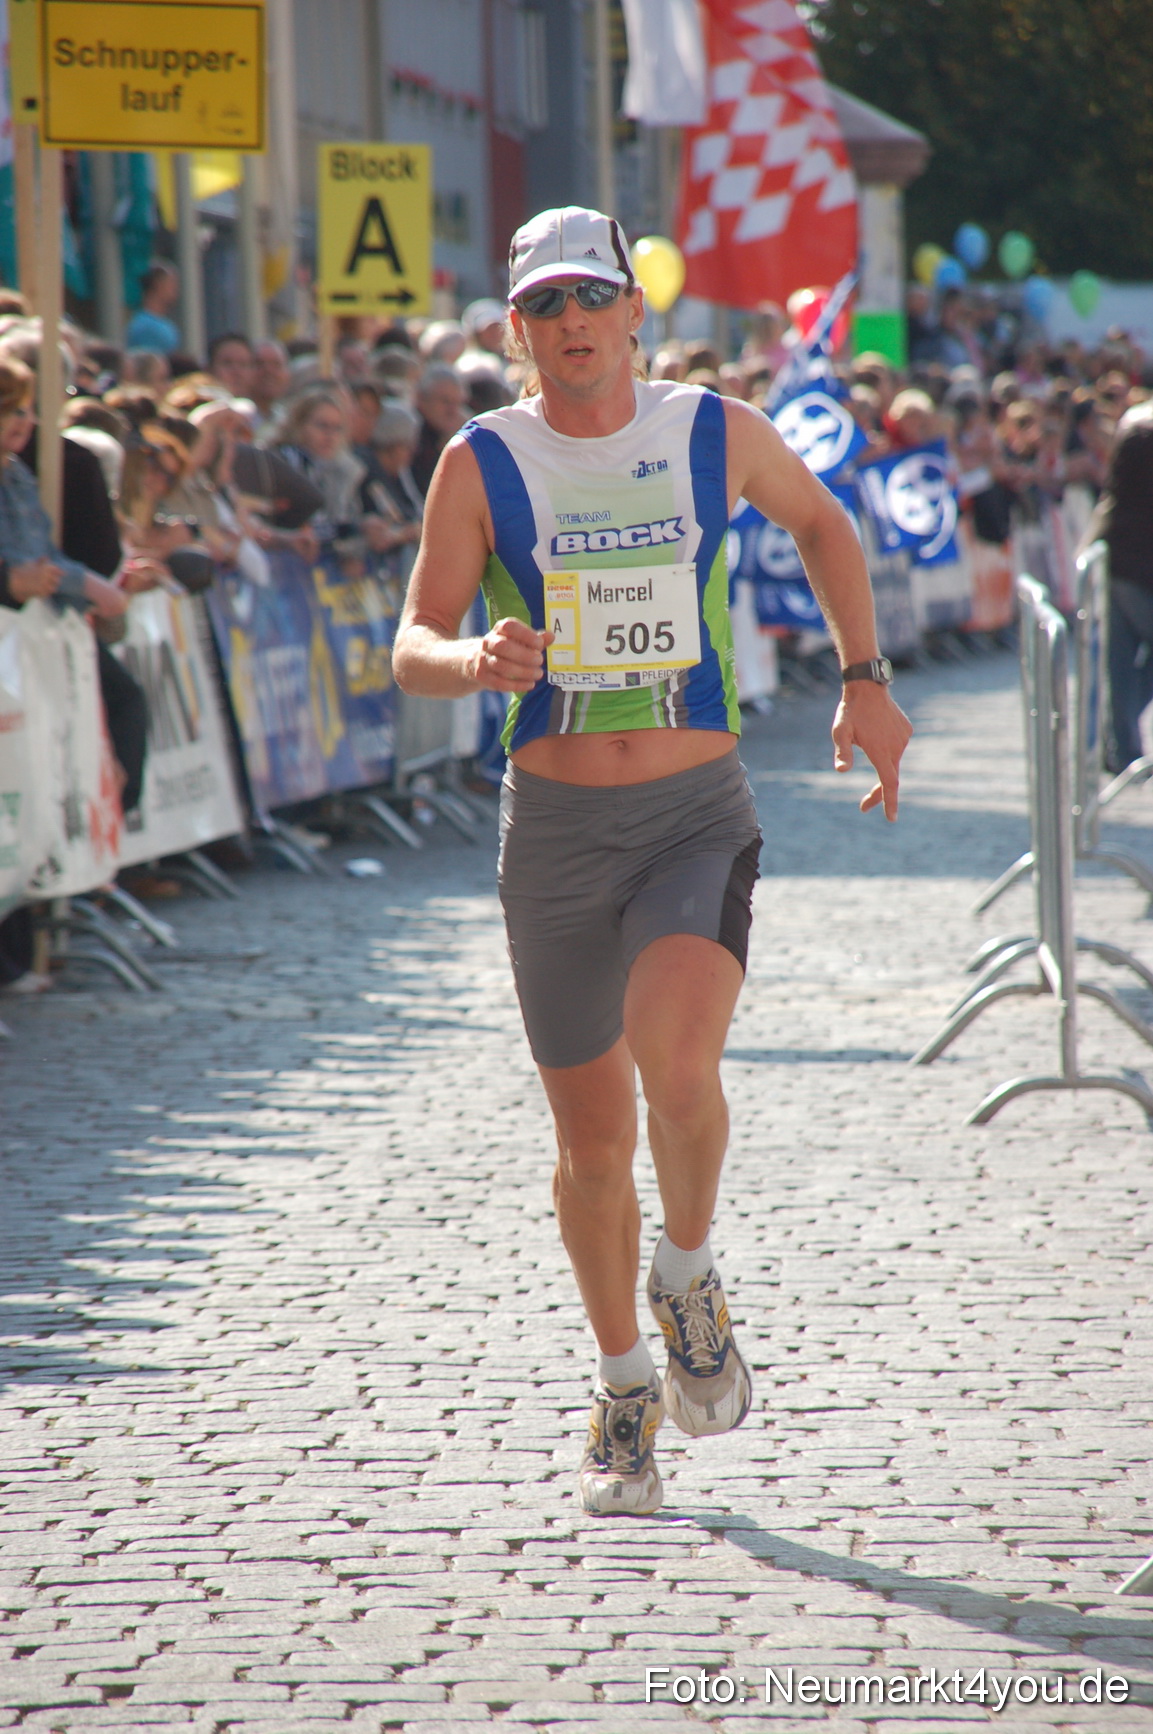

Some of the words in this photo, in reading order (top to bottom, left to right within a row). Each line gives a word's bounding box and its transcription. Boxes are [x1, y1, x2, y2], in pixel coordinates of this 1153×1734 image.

[54, 38, 248, 77] Schnupper-
[121, 83, 183, 112] lauf
[331, 150, 417, 182] Block
[346, 197, 404, 276] A
[556, 511, 610, 524] TEAM
[551, 516, 686, 556] BOCK
[587, 579, 653, 604] Marcel
[553, 618, 563, 634] A
[604, 620, 676, 656] 505
[550, 673, 606, 684] BOCK
